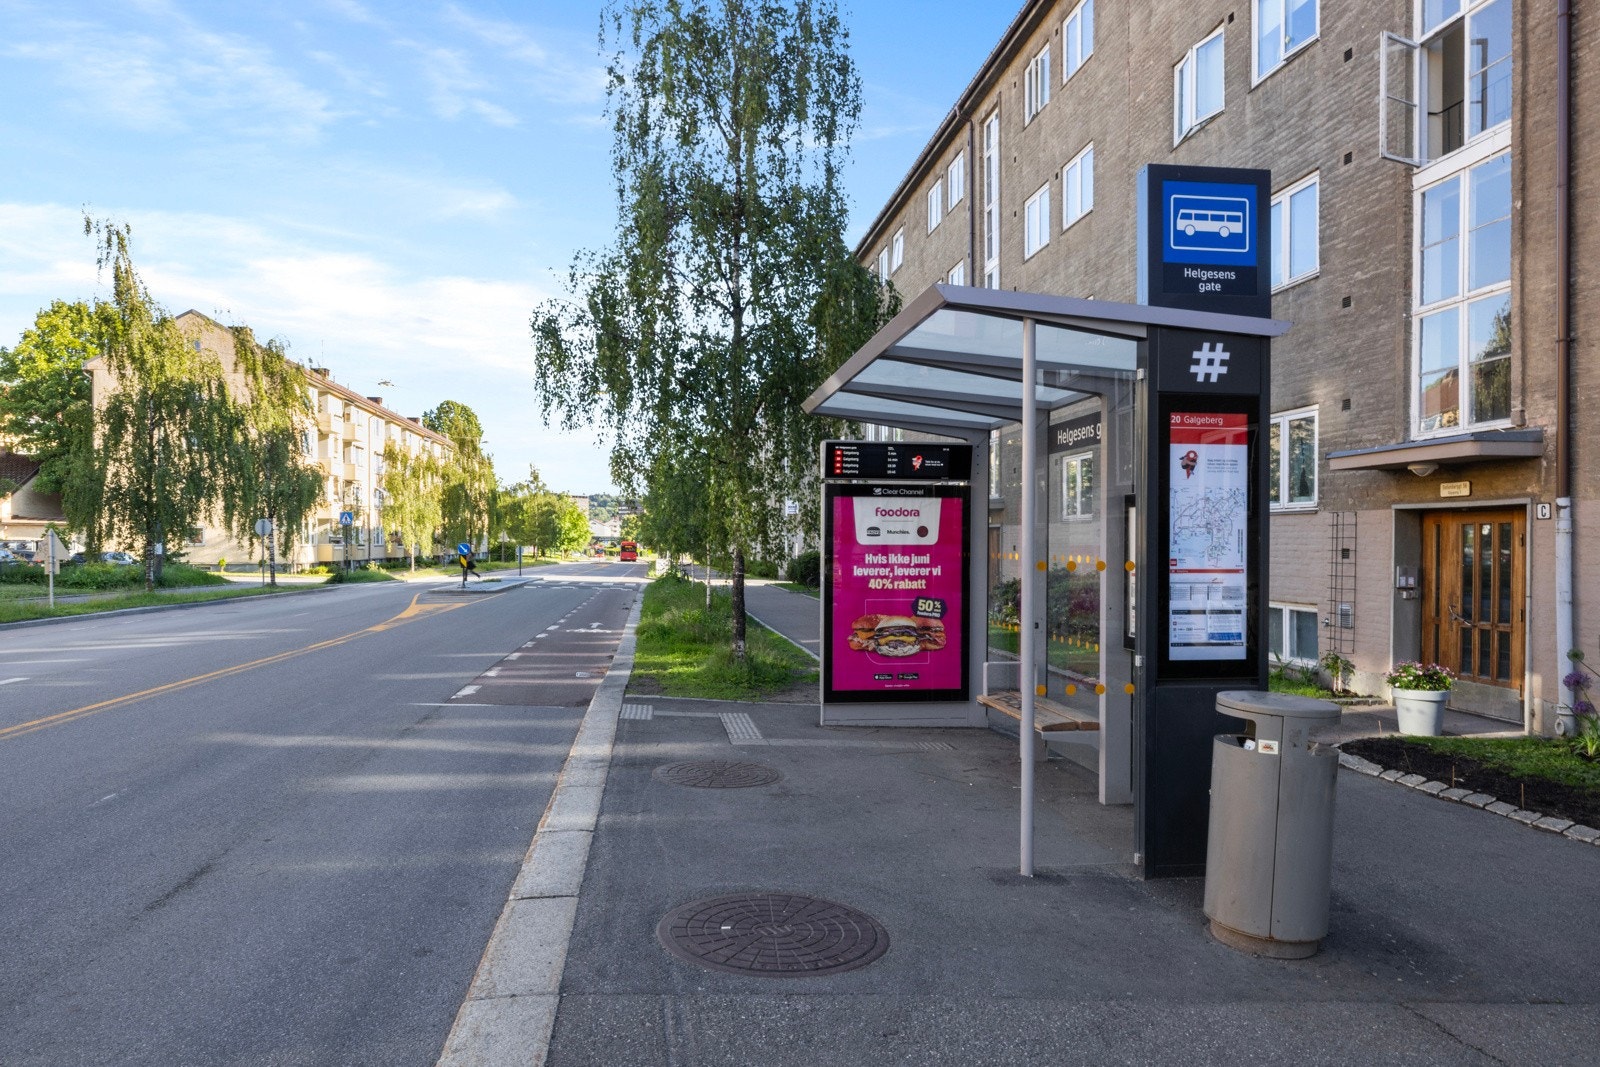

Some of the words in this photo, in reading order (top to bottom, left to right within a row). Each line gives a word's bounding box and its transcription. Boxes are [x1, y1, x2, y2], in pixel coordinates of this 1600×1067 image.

[1184, 268, 1236, 280] Helgesens
[1198, 281, 1222, 293] gate
[1171, 415, 1181, 424] 20
[1183, 415, 1224, 426] Galgeberg
[1057, 424, 1095, 446] Helgesens
[882, 487, 899, 495] Clear
[900, 487, 924, 495] Channel
[875, 507, 920, 517] foodora
[1541, 505, 1547, 517] C
[865, 553, 888, 564] Hvis
[888, 553, 910, 564] ikke
[911, 553, 930, 566] juni
[853, 566, 893, 577] leverer,
[894, 566, 930, 576] leverer
[931, 566, 941, 576] vi
[868, 579, 893, 590] 40%
[894, 579, 926, 590] rabatt
